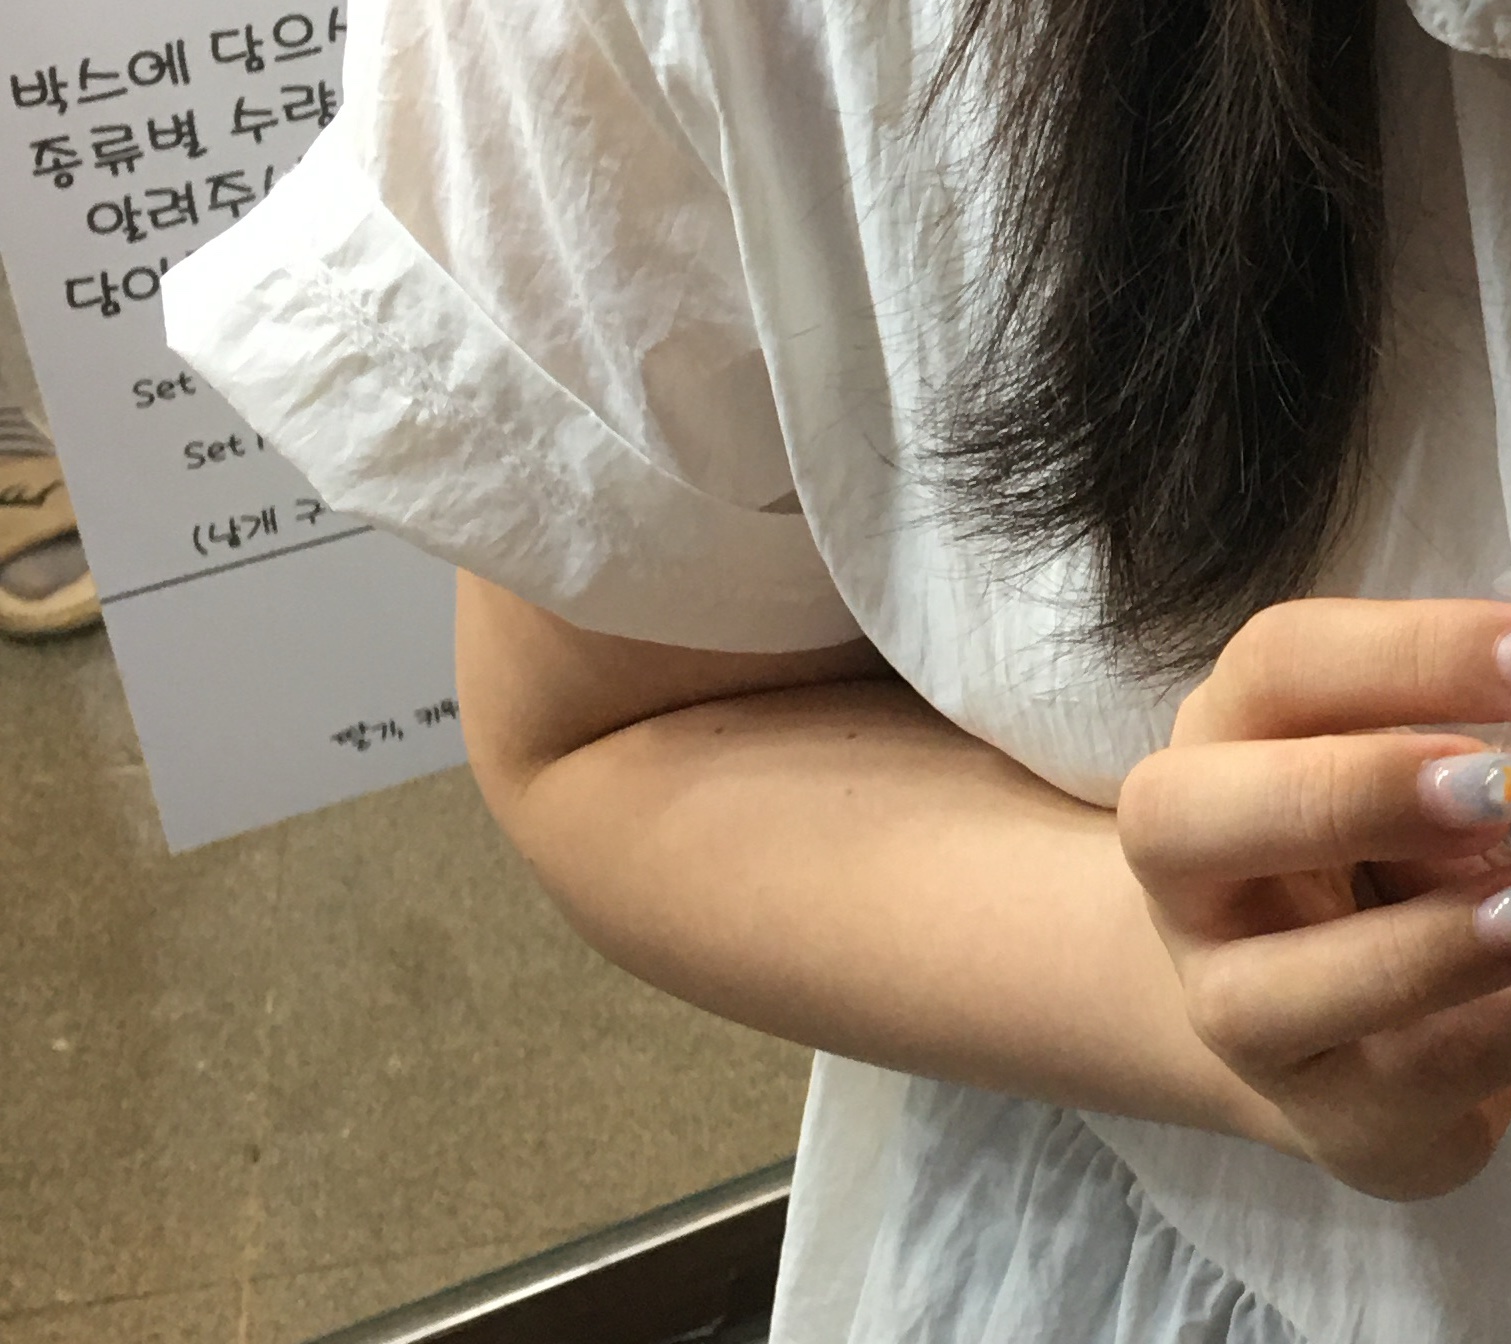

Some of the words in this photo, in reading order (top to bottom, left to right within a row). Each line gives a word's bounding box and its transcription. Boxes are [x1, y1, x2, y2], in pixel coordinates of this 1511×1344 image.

[10, 38, 191, 116] 박스에
[29, 108, 208, 190] 종류별
[230, 69, 338, 145] 수량
[86, 164, 275, 244] 알려주
[131, 370, 198, 410] Set
[183, 432, 246, 471] Set
